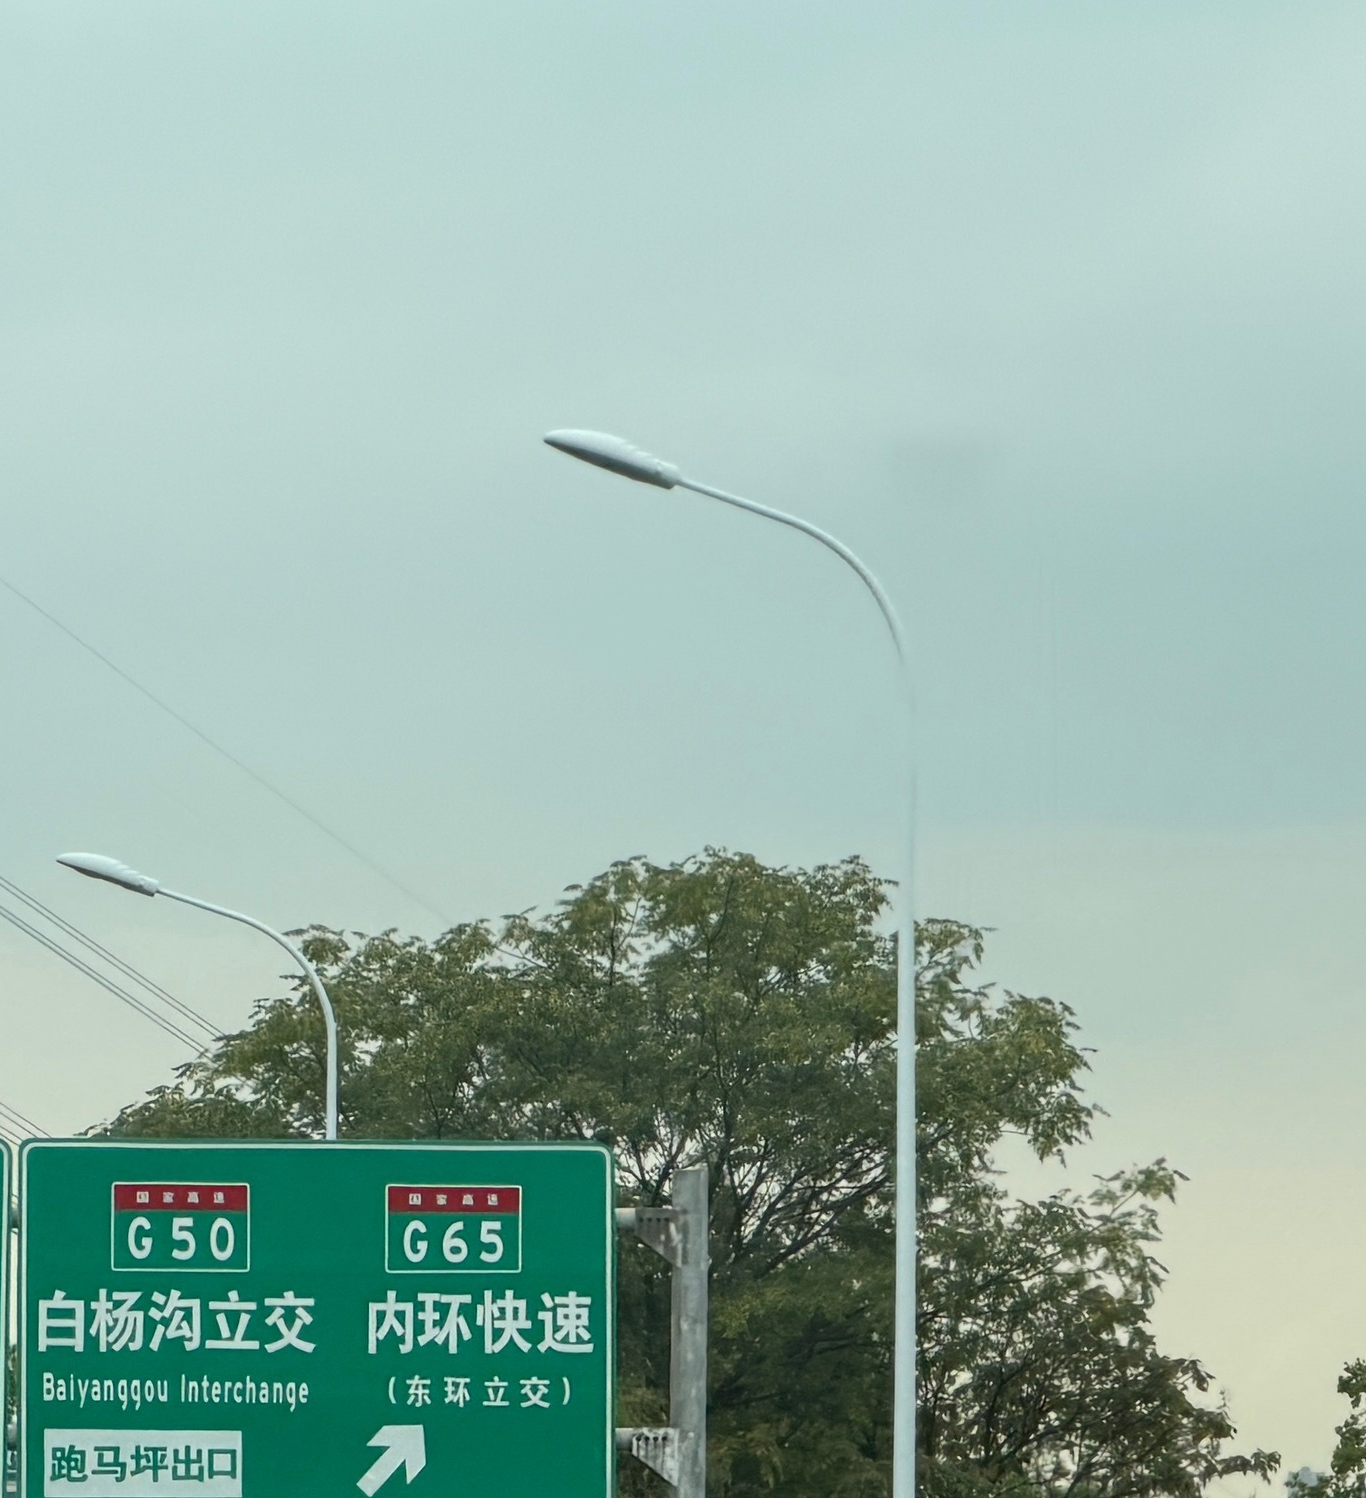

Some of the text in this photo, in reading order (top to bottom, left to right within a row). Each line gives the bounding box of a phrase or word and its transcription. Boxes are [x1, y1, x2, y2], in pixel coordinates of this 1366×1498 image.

[127, 1216, 235, 1261] G50
[403, 1219, 504, 1263] G65
[38, 1288, 316, 1353] 白杨沟立交
[368, 1289, 594, 1355] 内环快速
[43, 1372, 309, 1413] Baiyanggou Interchange
[49, 1444, 237, 1483] 跑马坪出口
